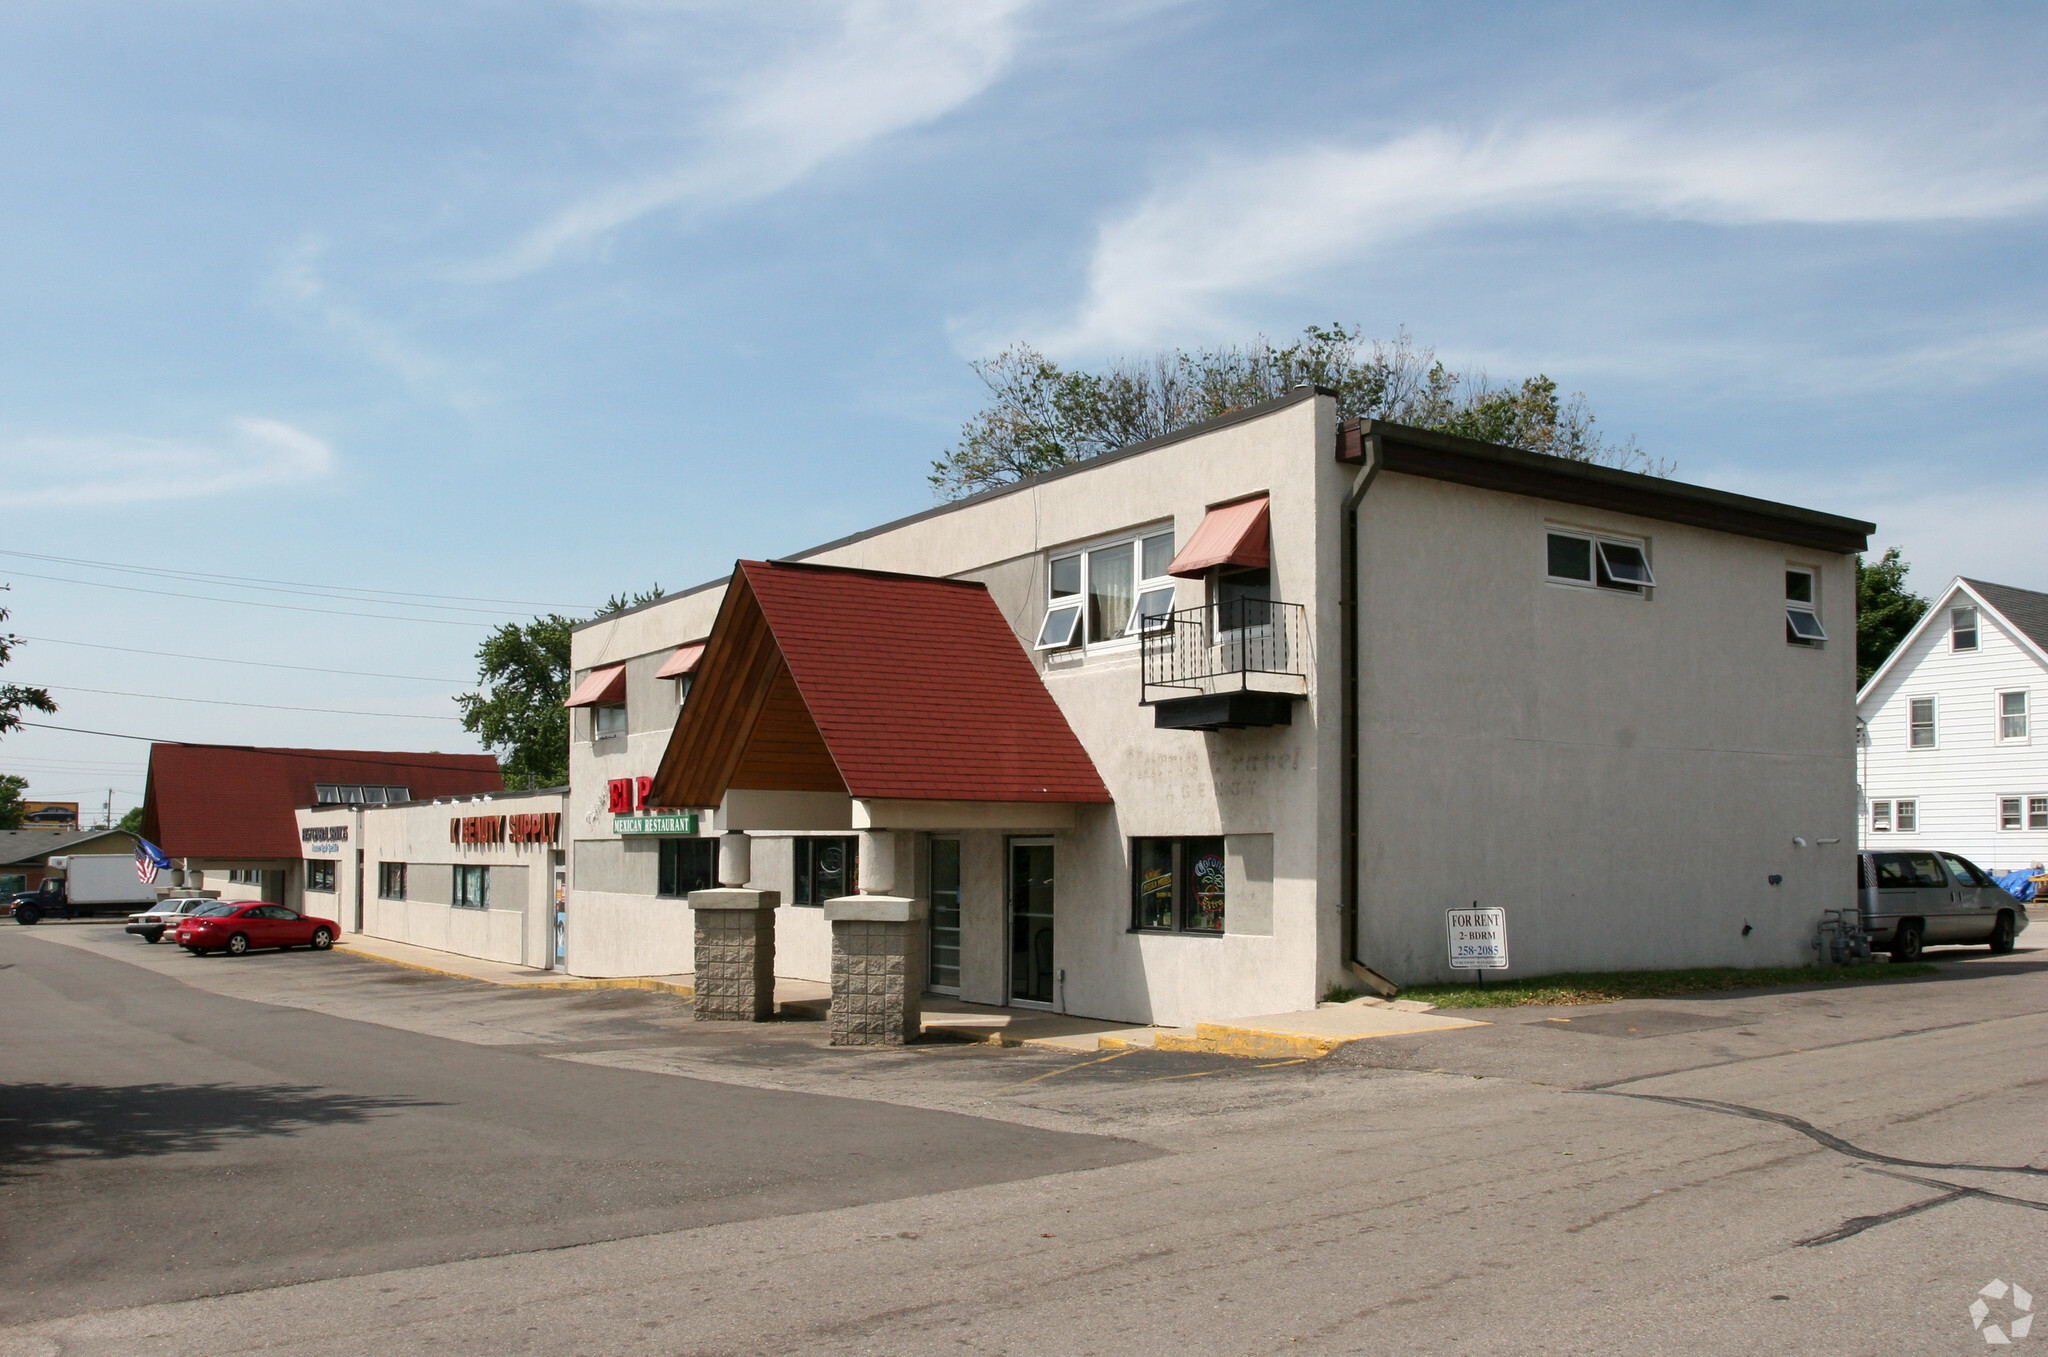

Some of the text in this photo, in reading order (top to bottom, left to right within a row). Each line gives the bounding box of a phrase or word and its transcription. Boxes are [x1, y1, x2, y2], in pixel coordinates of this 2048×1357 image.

[462, 815, 505, 843] BEAUTY
[509, 813, 559, 843] SUPPLY
[614, 818, 689, 832] MEXICAN RESTAURANT
[1452, 914, 1499, 927] FOR RENT
[1458, 945, 1499, 956] 258-2085
